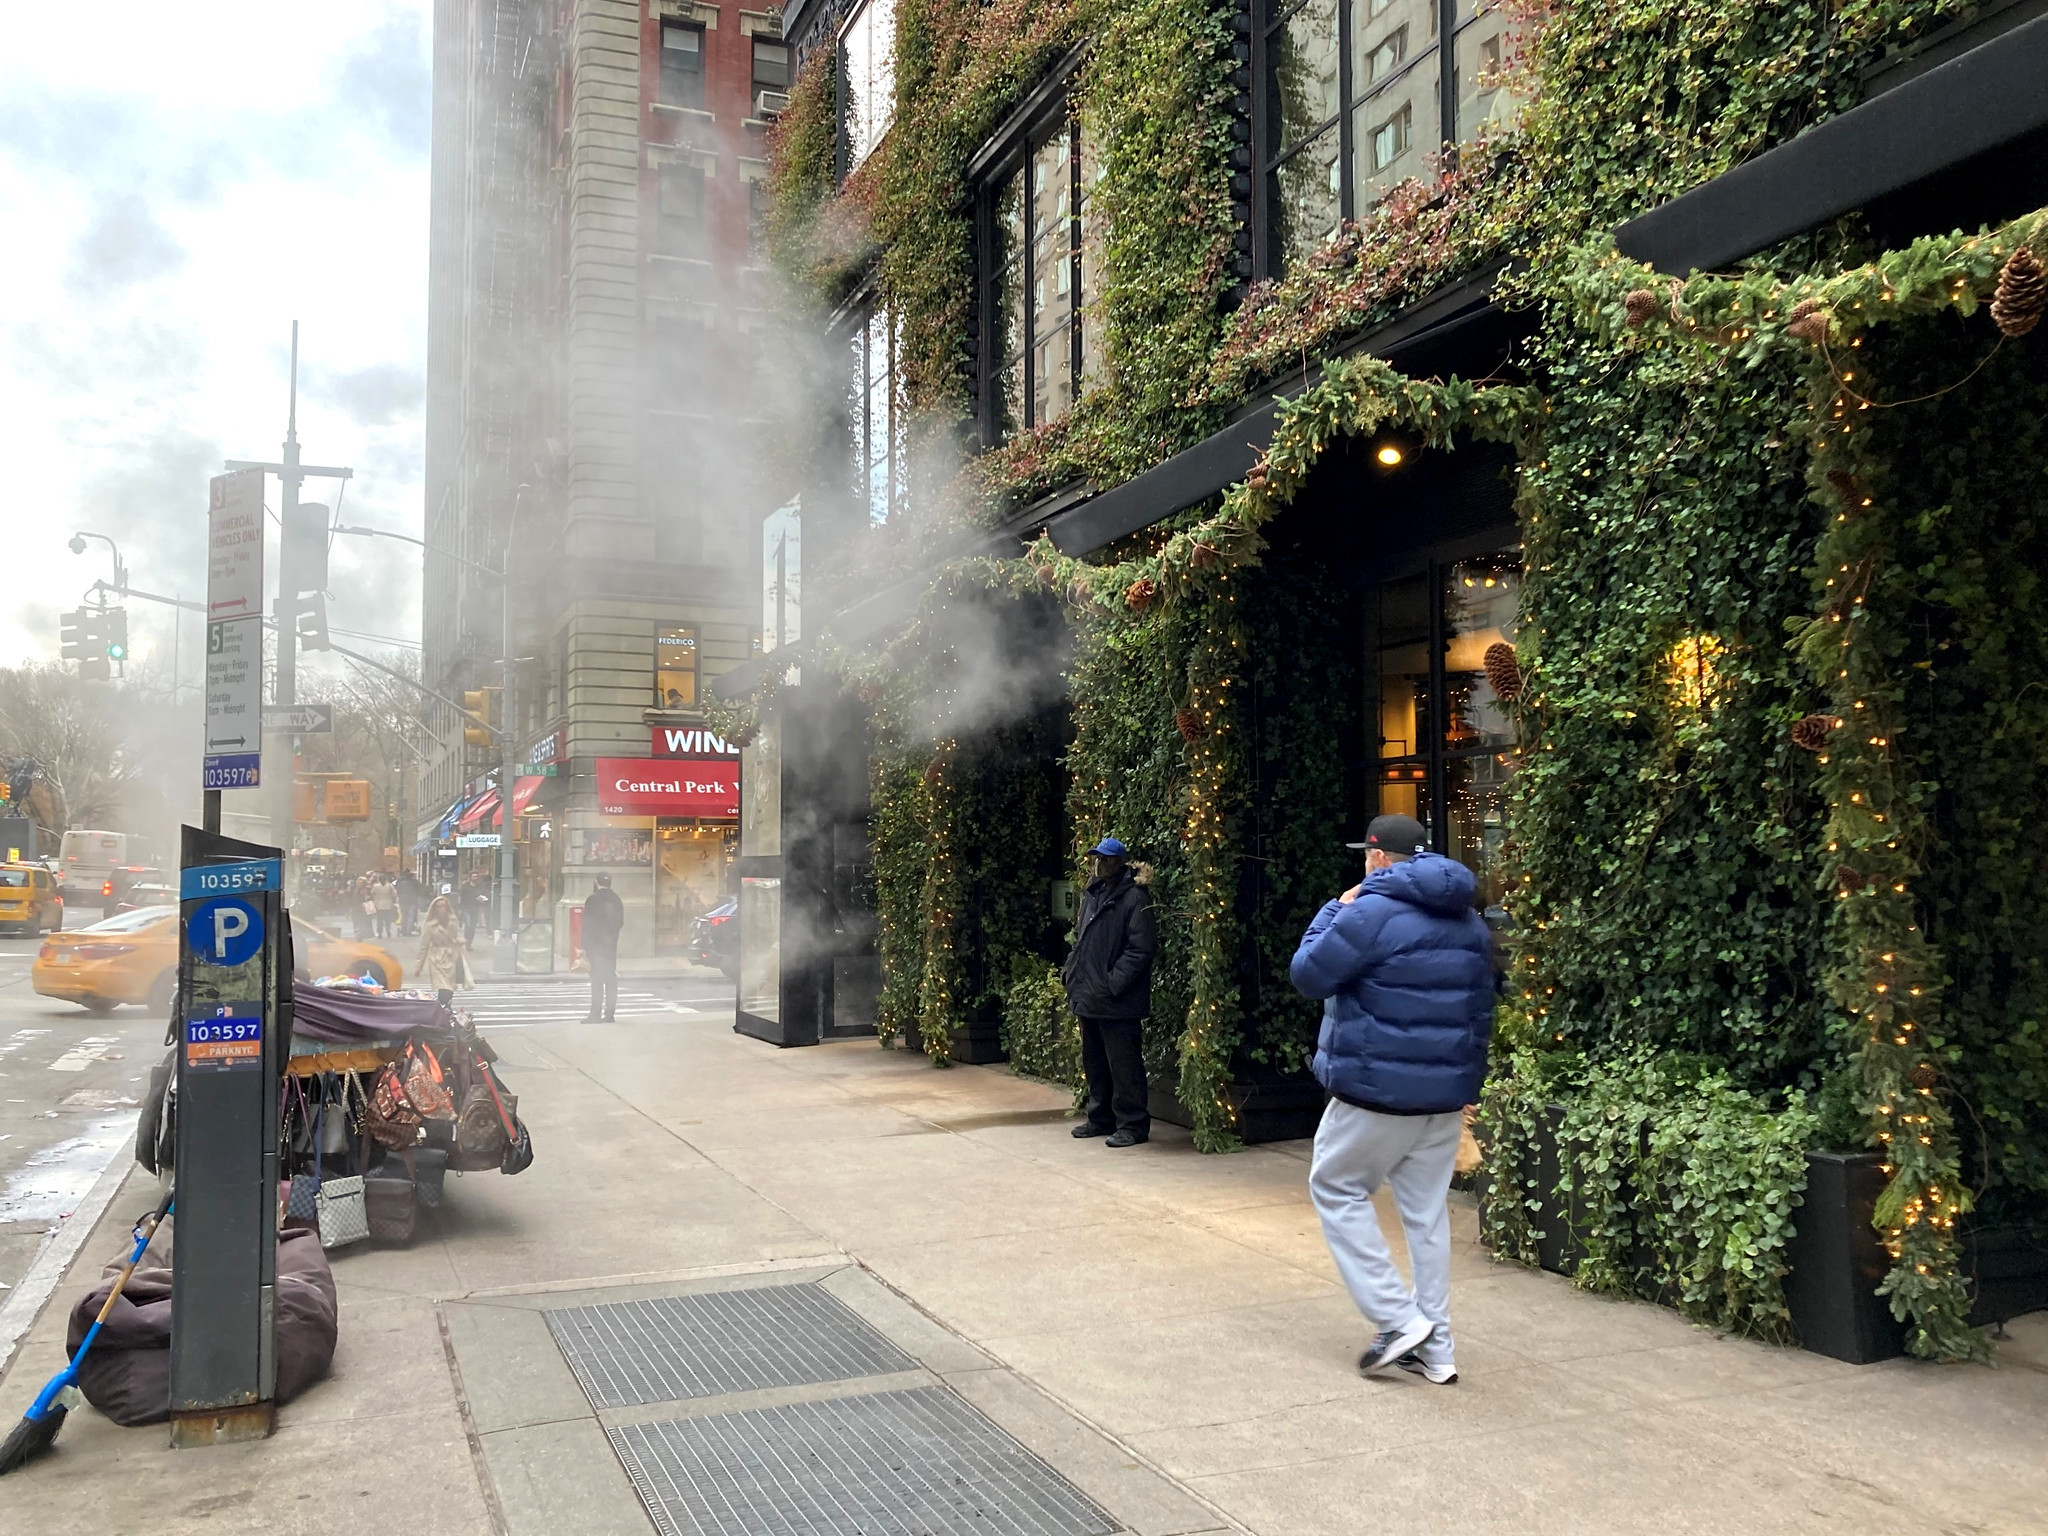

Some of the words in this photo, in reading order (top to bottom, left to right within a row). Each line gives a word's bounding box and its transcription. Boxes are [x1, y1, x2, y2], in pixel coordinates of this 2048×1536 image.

[242, 527, 261, 543] ONLY
[211, 625, 220, 652] 5
[658, 637, 694, 646] FEDERICO
[232, 659, 249, 670] Friday
[208, 693, 231, 706] Saturday
[290, 713, 318, 725] WAY
[525, 765, 534, 774] W
[536, 765, 547, 775] 58
[204, 767, 246, 787] 103597
[615, 779, 681, 793] Central
[684, 780, 726, 794] Perk
[604, 806, 623, 814] 1420
[213, 907, 249, 958] P
[191, 1024, 257, 1041] 103597
[209, 1046, 254, 1056] PARKNYC
